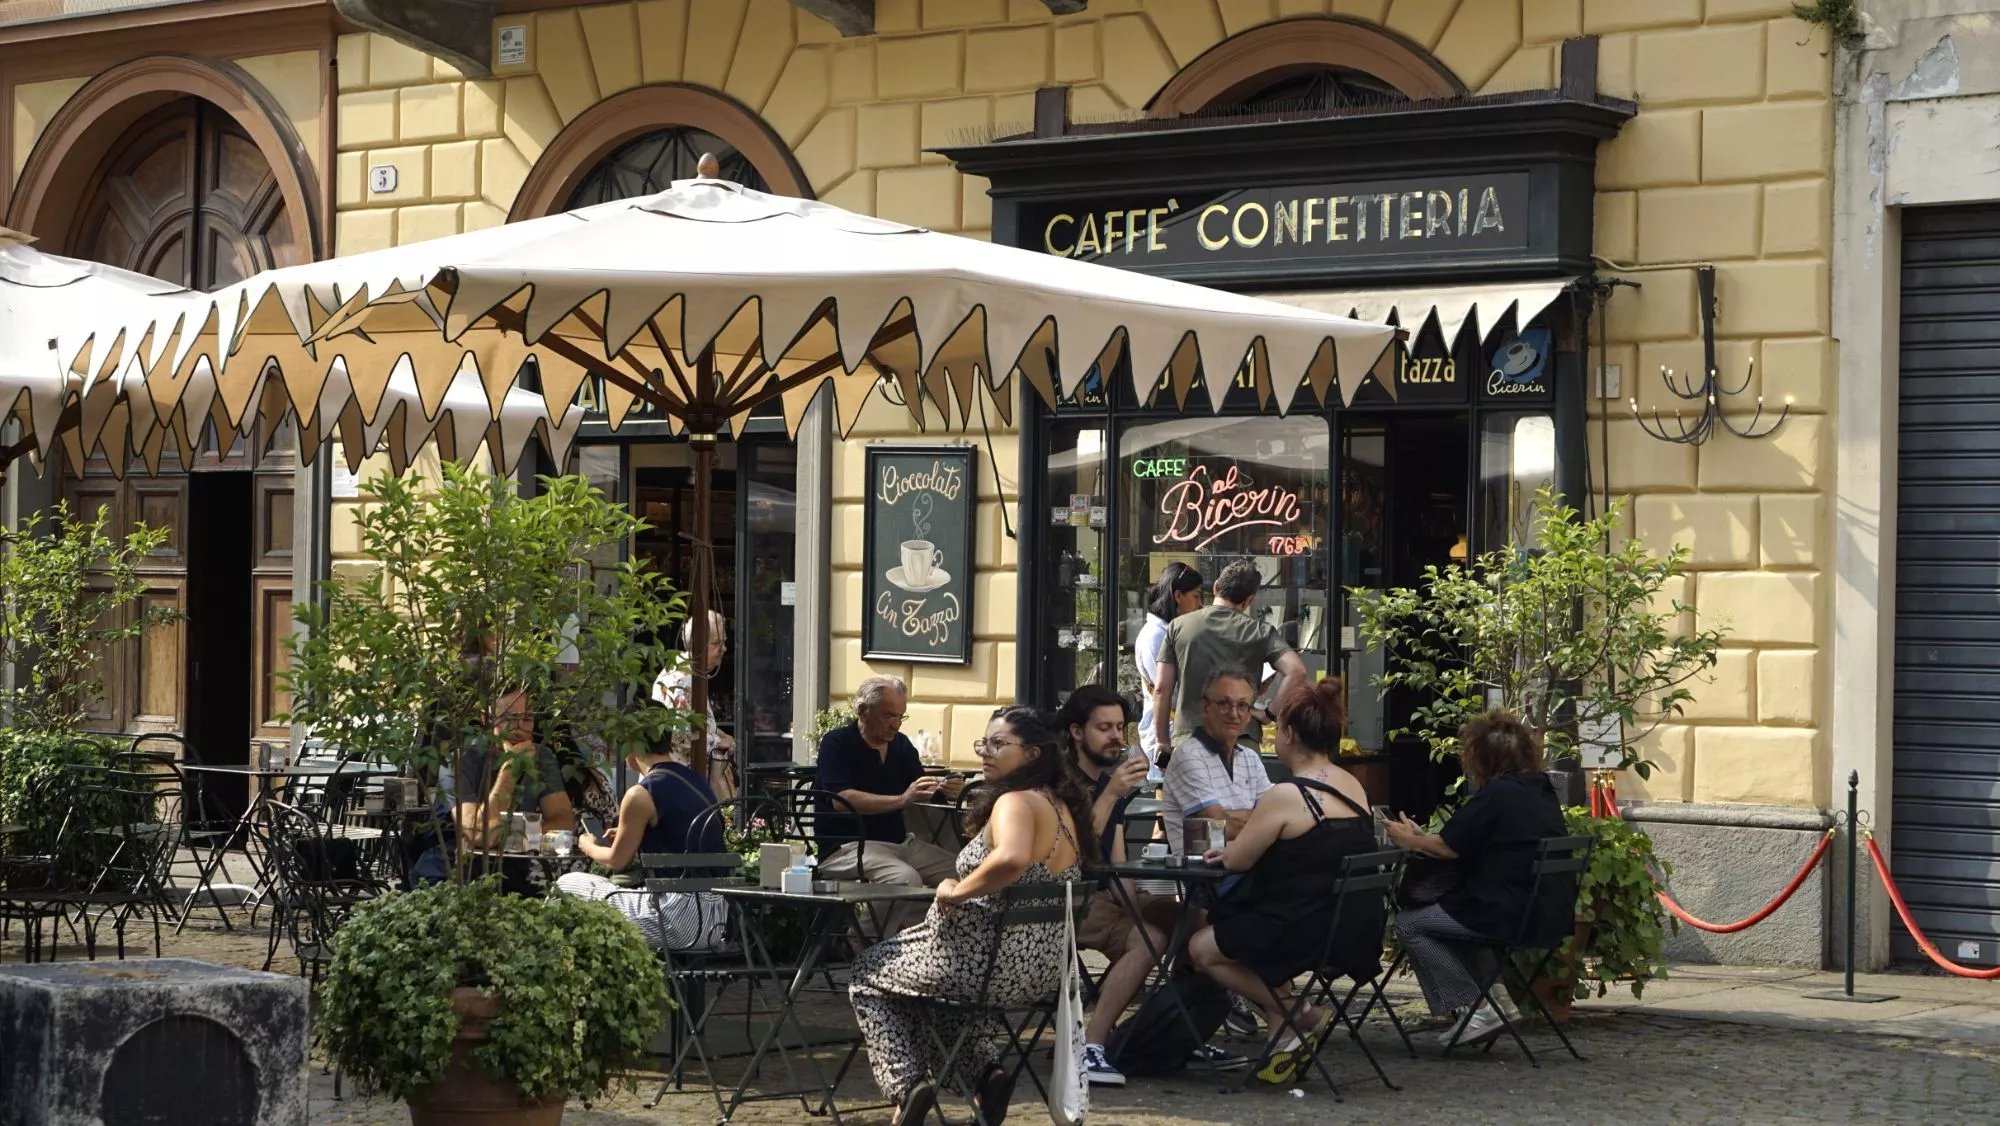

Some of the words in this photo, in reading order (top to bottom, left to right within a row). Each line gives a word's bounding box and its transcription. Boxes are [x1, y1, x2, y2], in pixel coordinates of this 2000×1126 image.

[378, 169, 387, 189] 5
[1197, 186, 1505, 250] CONFETTERIA
[1400, 351, 1457, 384] tazza
[1486, 369, 1546, 396] Bicerin
[1212, 465, 1239, 494] al
[1152, 465, 1301, 544] Bicerin
